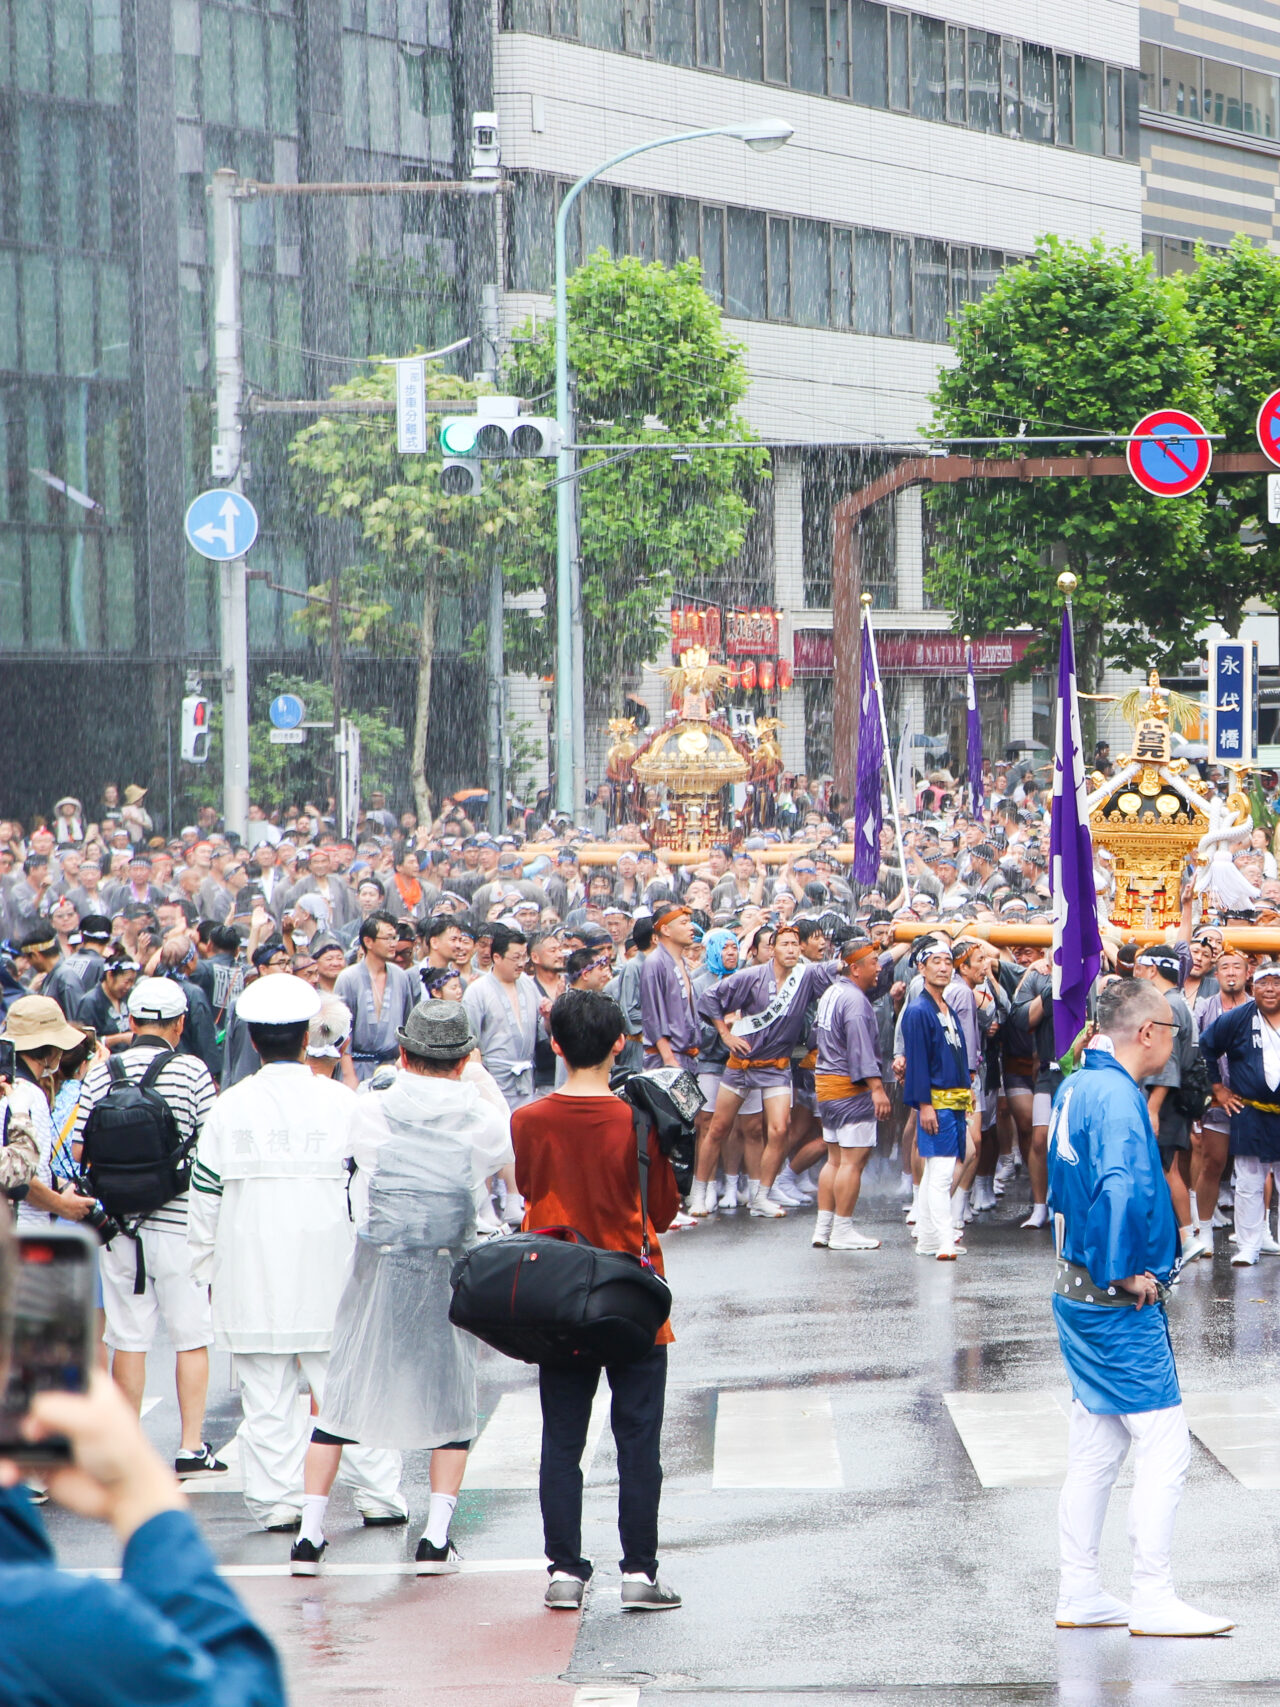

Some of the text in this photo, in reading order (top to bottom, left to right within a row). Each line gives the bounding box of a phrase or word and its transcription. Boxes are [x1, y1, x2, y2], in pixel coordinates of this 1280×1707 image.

[979, 645, 1013, 663] LAWSON
[1220, 655, 1241, 750] 永代橋
[232, 1129, 329, 1154] 警視庁
